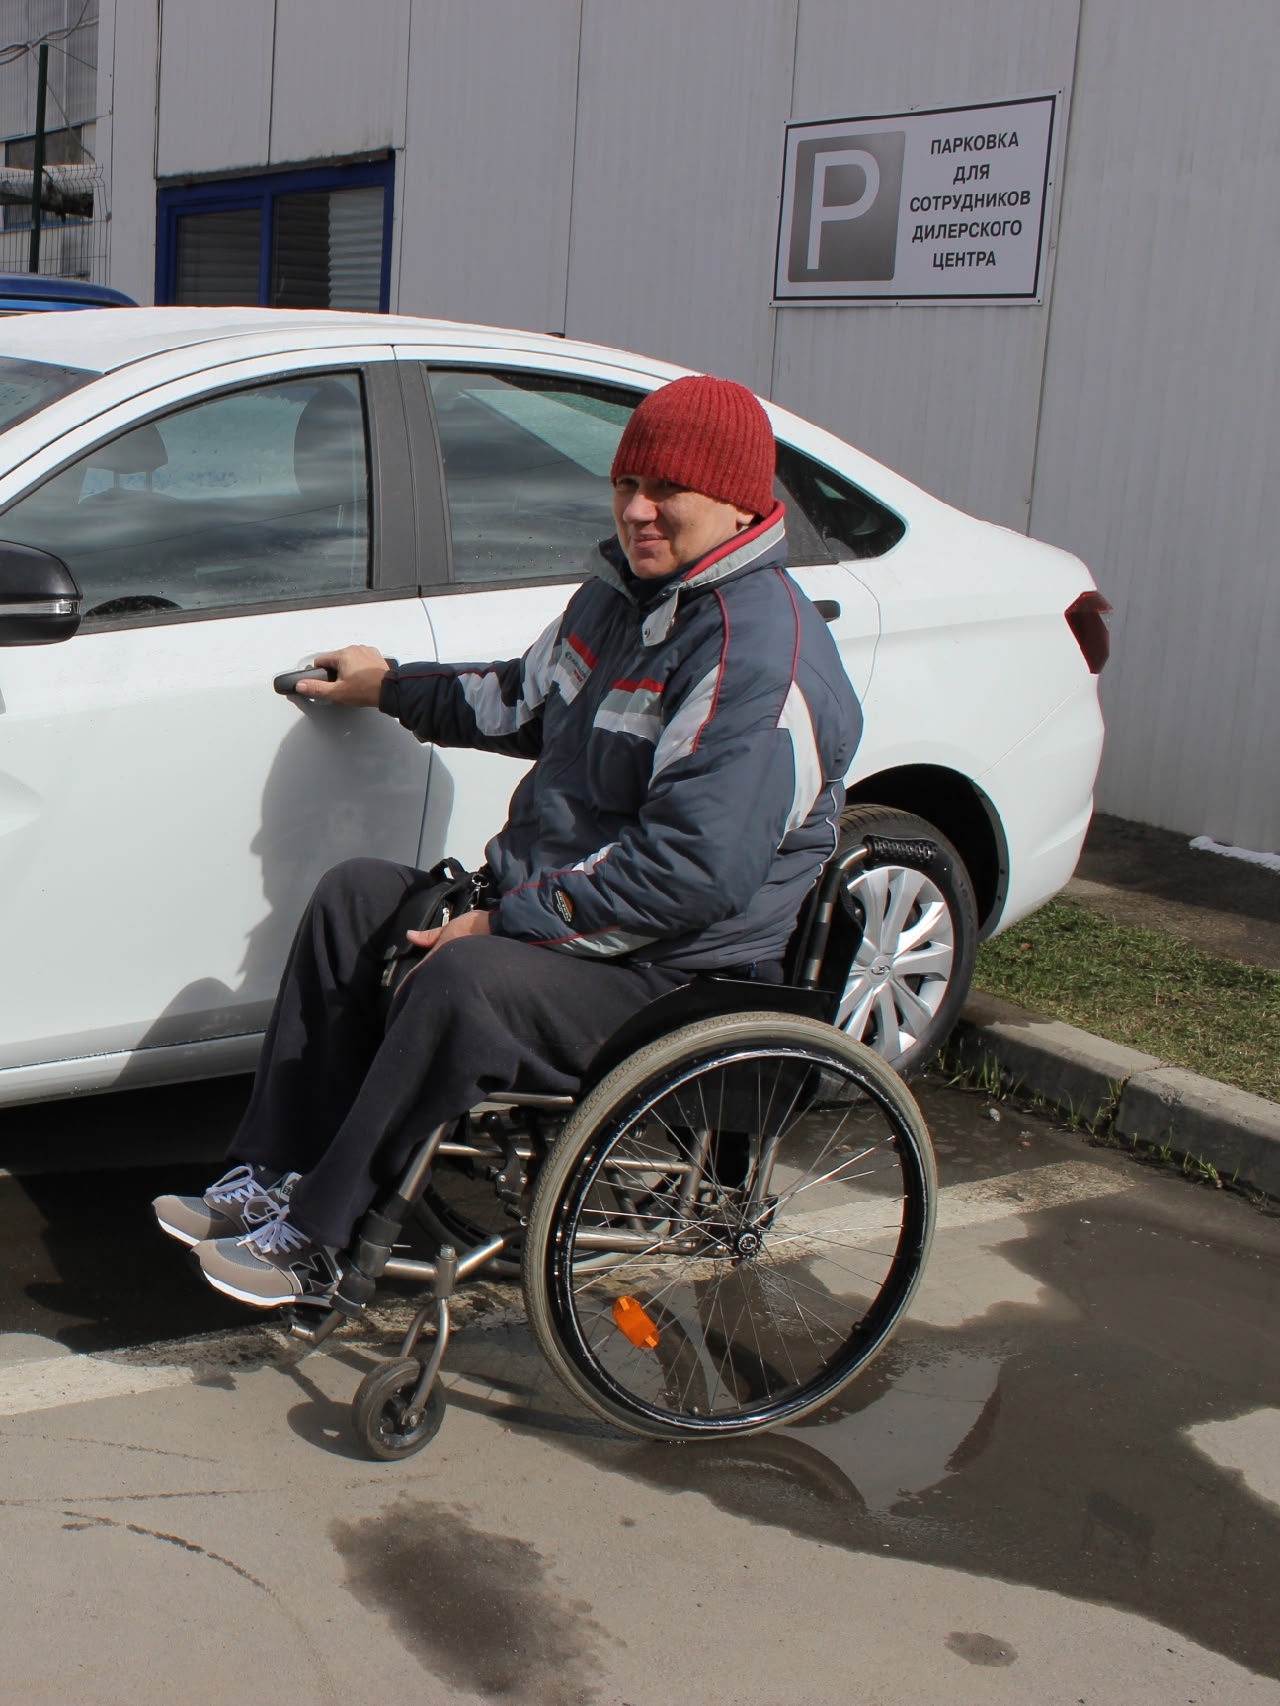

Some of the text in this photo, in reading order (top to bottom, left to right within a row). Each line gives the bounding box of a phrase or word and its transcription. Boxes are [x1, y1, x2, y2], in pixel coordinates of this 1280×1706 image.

[930, 131, 1019, 155] ПАРКОВКА
[952, 163, 990, 185] ДЛЯ
[806, 149, 881, 270] P
[909, 190, 1031, 213] СОТРУДНИКОВ
[911, 219, 1022, 243] ДИЛЕРСКОГО
[932, 250, 997, 271] ЦЕНТРА
